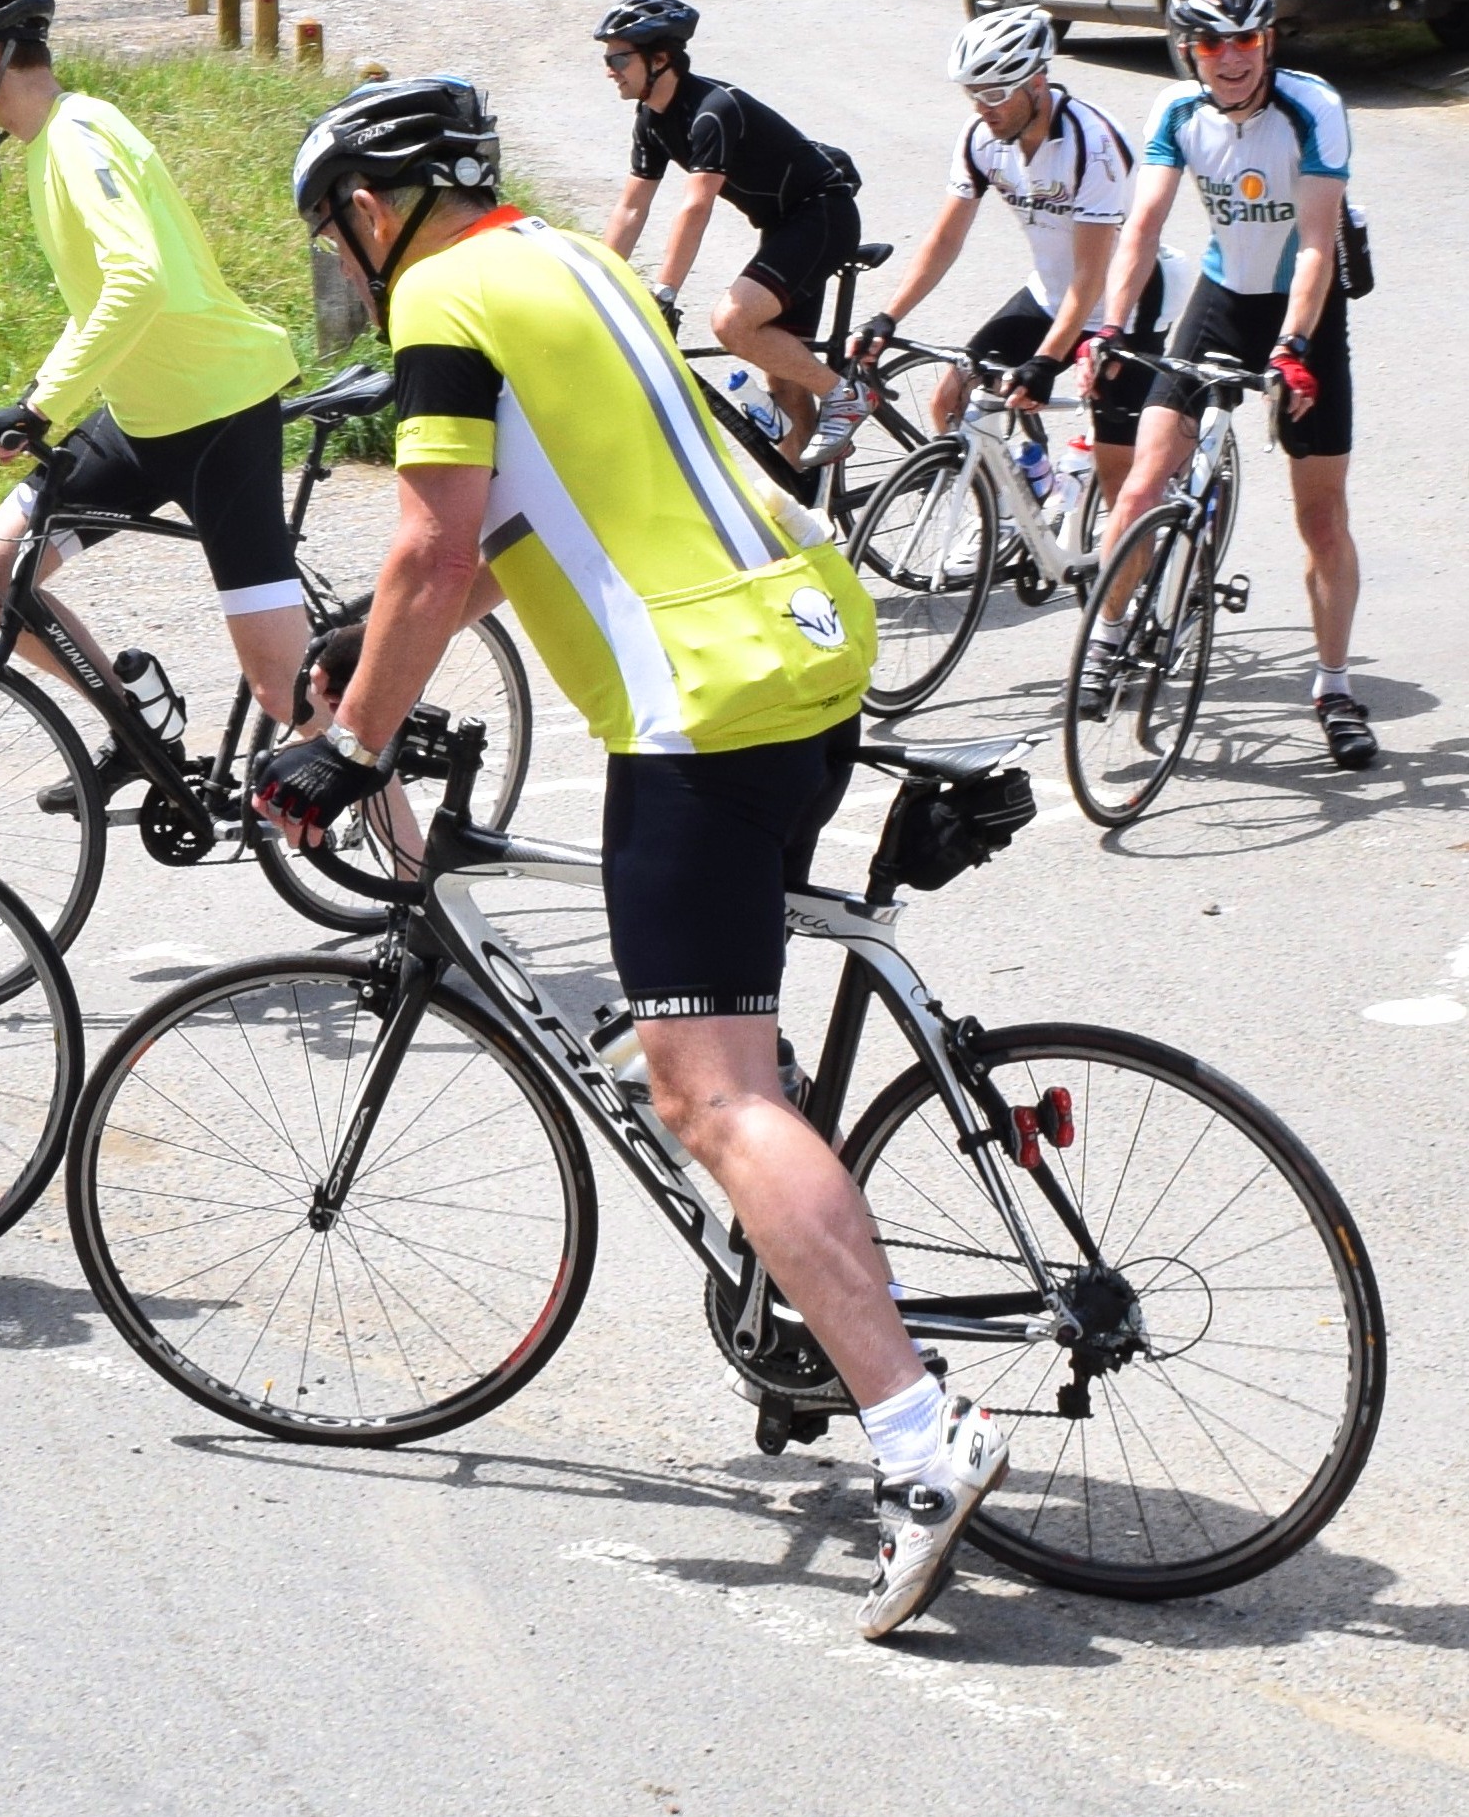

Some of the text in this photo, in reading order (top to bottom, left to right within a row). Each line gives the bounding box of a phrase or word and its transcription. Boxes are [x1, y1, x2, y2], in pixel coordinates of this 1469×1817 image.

[45, 622, 104, 689] SPECIALIZED
[480, 940, 707, 1243] ORBEA
[327, 1105, 371, 1201] ORBEA
